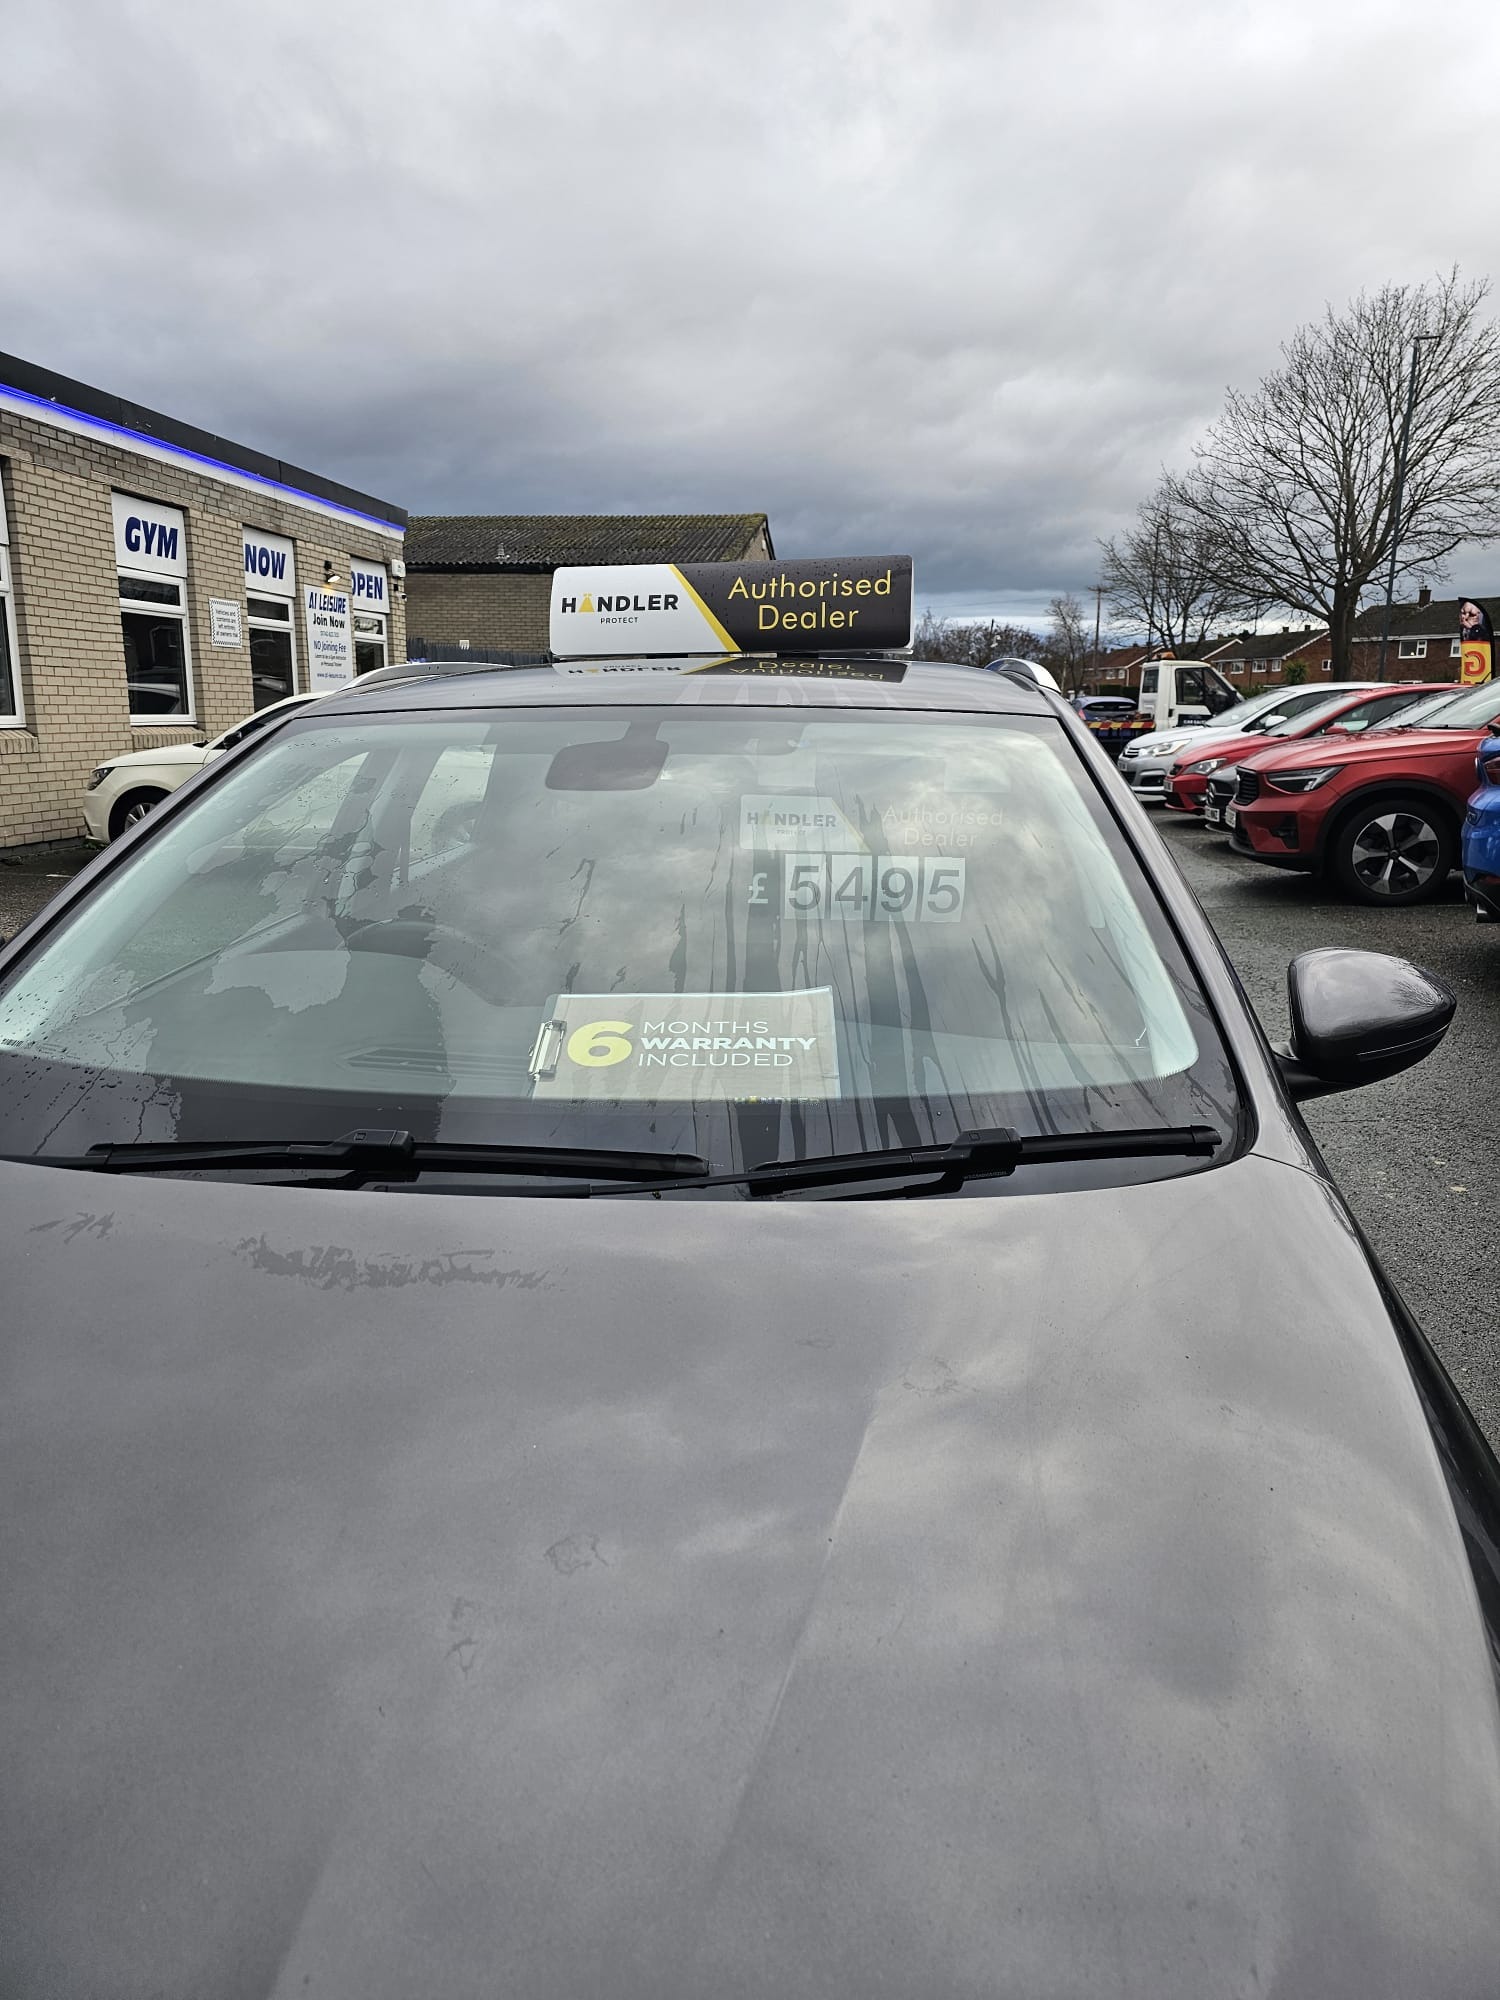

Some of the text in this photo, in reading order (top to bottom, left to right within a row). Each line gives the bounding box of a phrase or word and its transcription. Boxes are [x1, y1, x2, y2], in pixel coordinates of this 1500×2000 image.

[124, 516, 179, 561] GYM
[244, 543, 287, 580] NOW
[727, 569, 892, 600] Authorised
[319, 593, 347, 615] LEISURE
[313, 612, 346, 629] Join Now
[600, 617, 639, 625] PROTECT
[758, 602, 859, 631] Dealer
[881, 803, 1003, 826] Authorised
[903, 827, 978, 847] Dealer
[642, 1021, 769, 1034] MONTHS
[567, 1020, 634, 1068] 6
[641, 1037, 816, 1050] WARRANTY
[638, 1053, 793, 1067] INCLUDED
